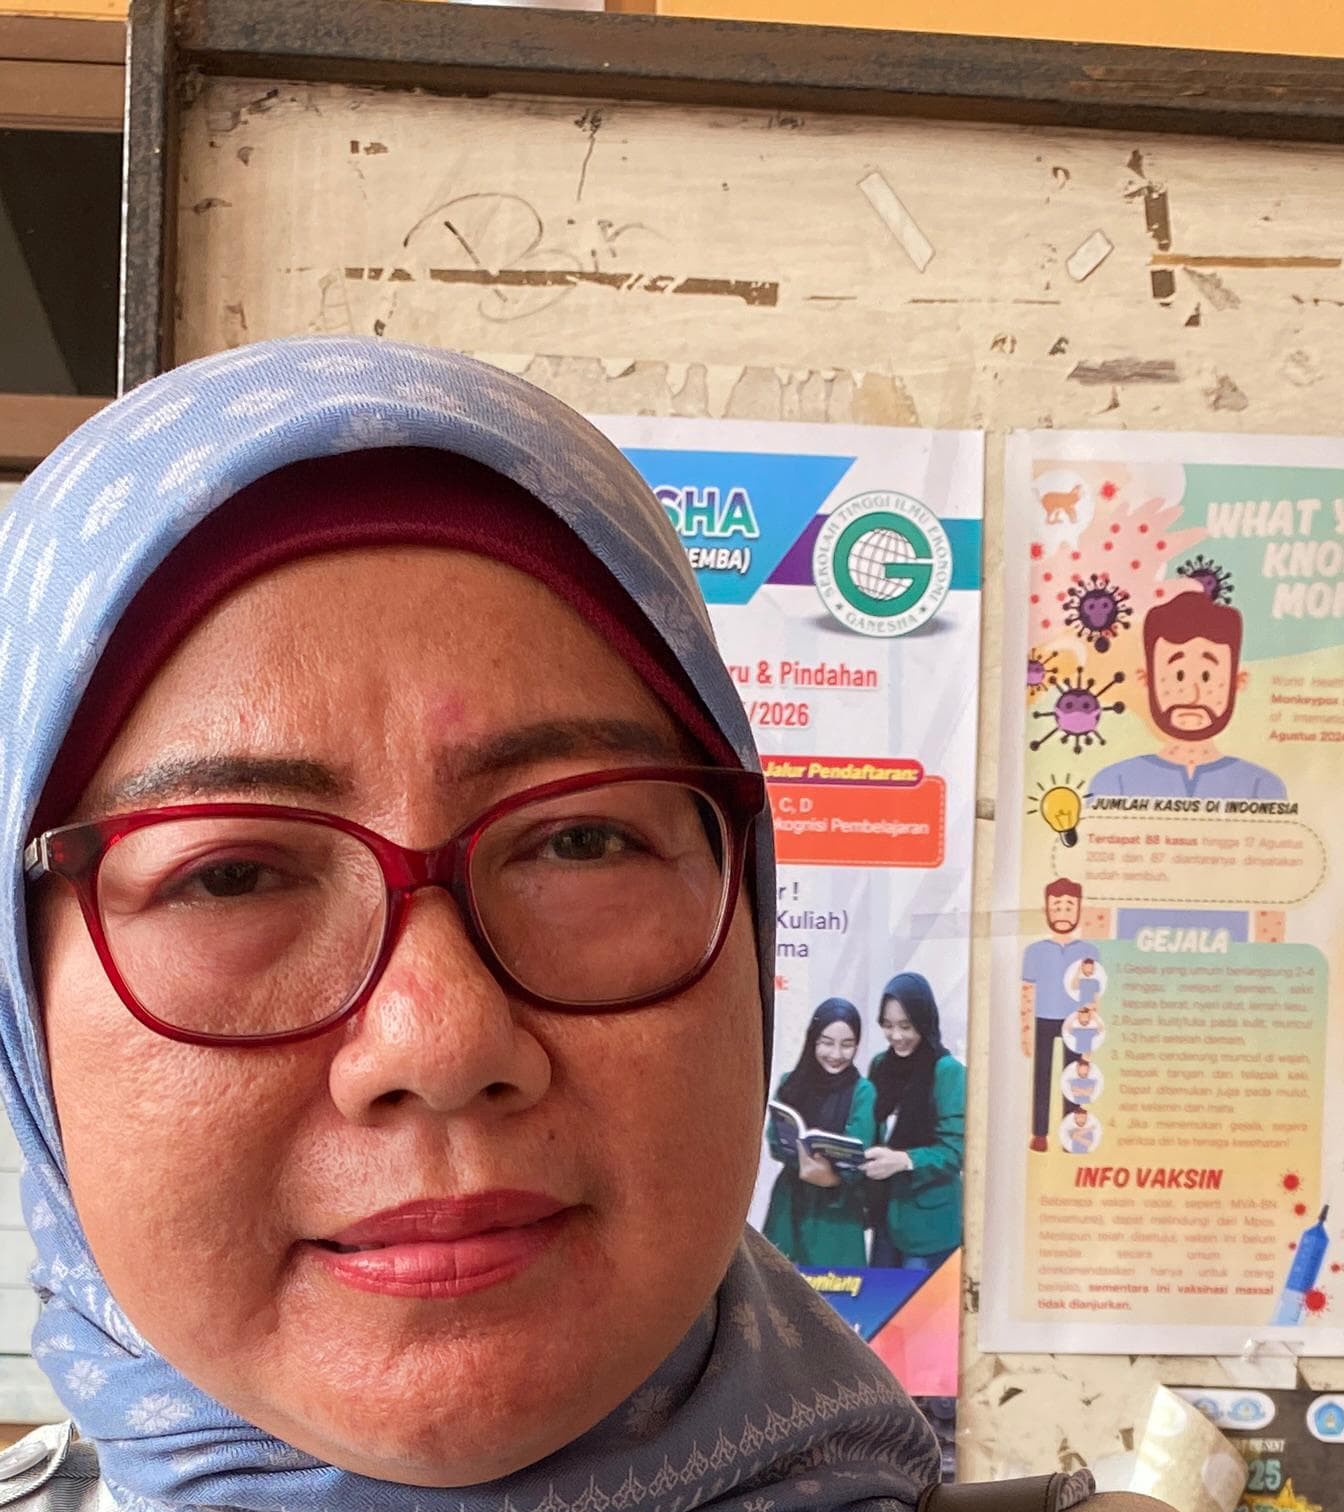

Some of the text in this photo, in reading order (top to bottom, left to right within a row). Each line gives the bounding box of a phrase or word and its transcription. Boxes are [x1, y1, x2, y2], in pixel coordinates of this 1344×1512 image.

[838, 494, 891, 520] TINGGI
[1207, 498, 1321, 538] WHAT
[686, 546, 752, 574] EMBA)
[846, 611, 919, 633] GANESHA
[757, 660, 773, 684] &
[780, 661, 878, 688] Pindahan
[1271, 695, 1338, 706] Monkeypox
[743, 701, 810, 726] /2026
[765, 761, 919, 782] Jalur Pendaftaran:
[799, 798, 813, 813] D
[1092, 798, 1299, 815] JUMLAH KASUS DI INDONESIA
[774, 818, 929, 837] kognisi Pembelajaran
[777, 910, 849, 934] Kuliah)
[1137, 927, 1230, 953] GEJALA
[1075, 1167, 1223, 1190] INFO VAKSIN
